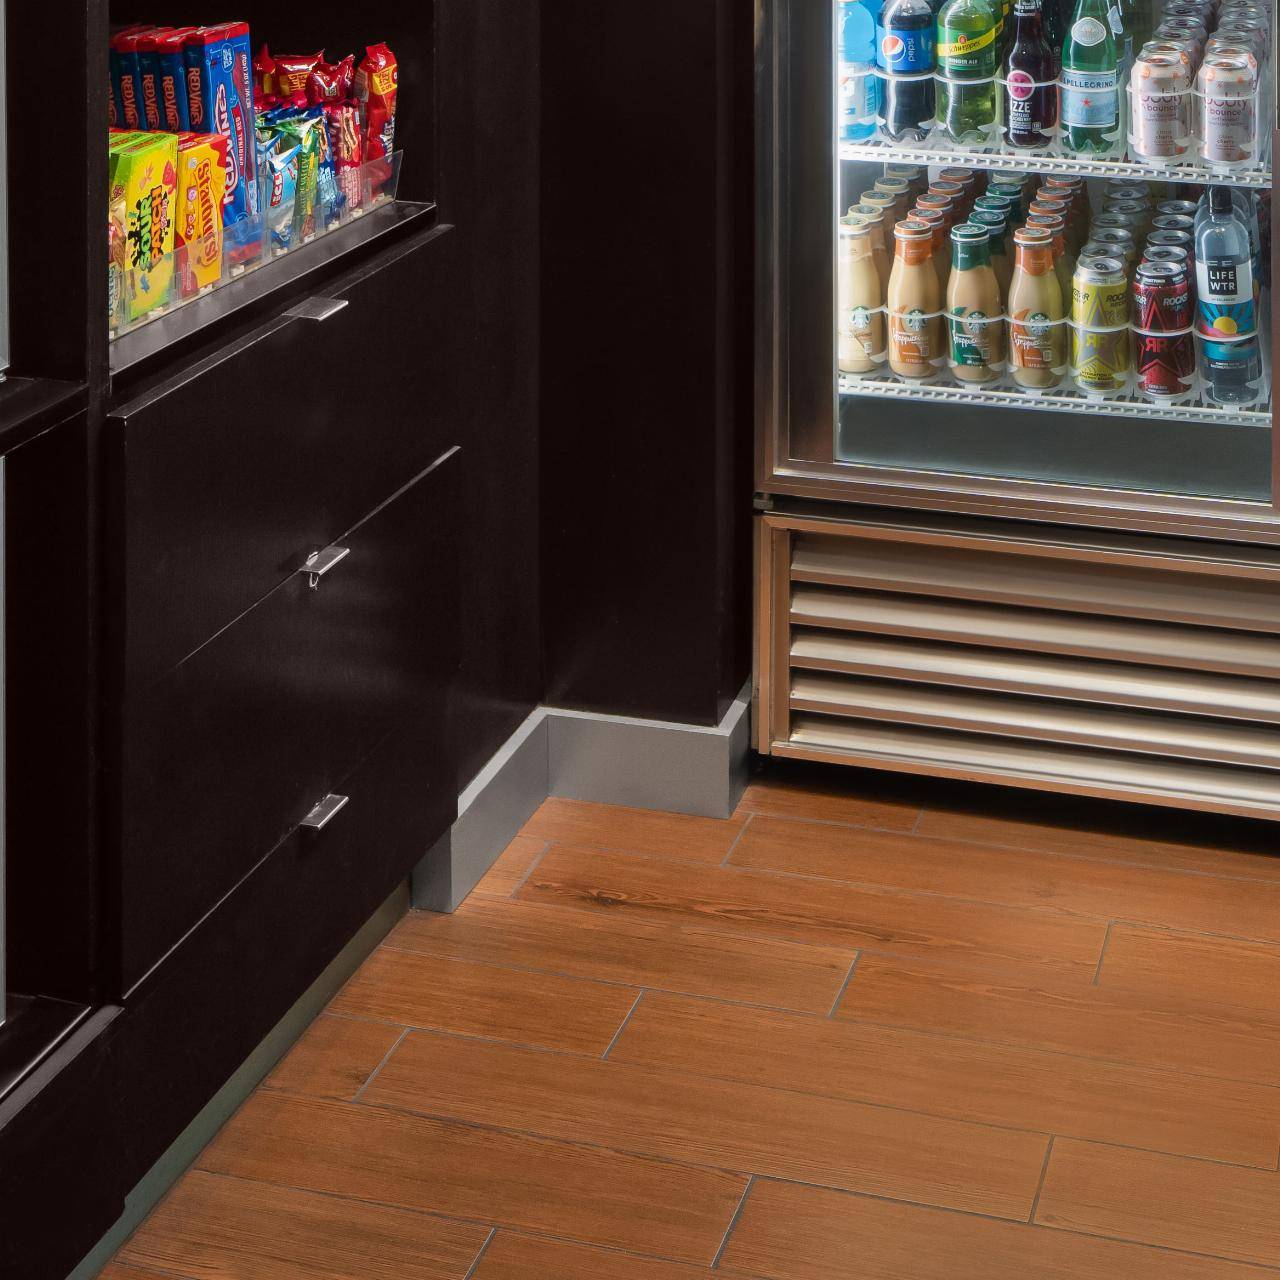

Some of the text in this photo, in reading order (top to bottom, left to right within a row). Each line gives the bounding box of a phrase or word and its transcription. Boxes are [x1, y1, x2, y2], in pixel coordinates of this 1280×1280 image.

[906, 37, 916, 62] pepsi
[1210, 108, 1242, 117] bounce
[150, 185, 163, 262] PATCH
[196, 160, 219, 265] Starburst
[139, 196, 153, 269] SOUR
[1209, 271, 1236, 280] LIFE
[1209, 281, 1237, 291] WTR
